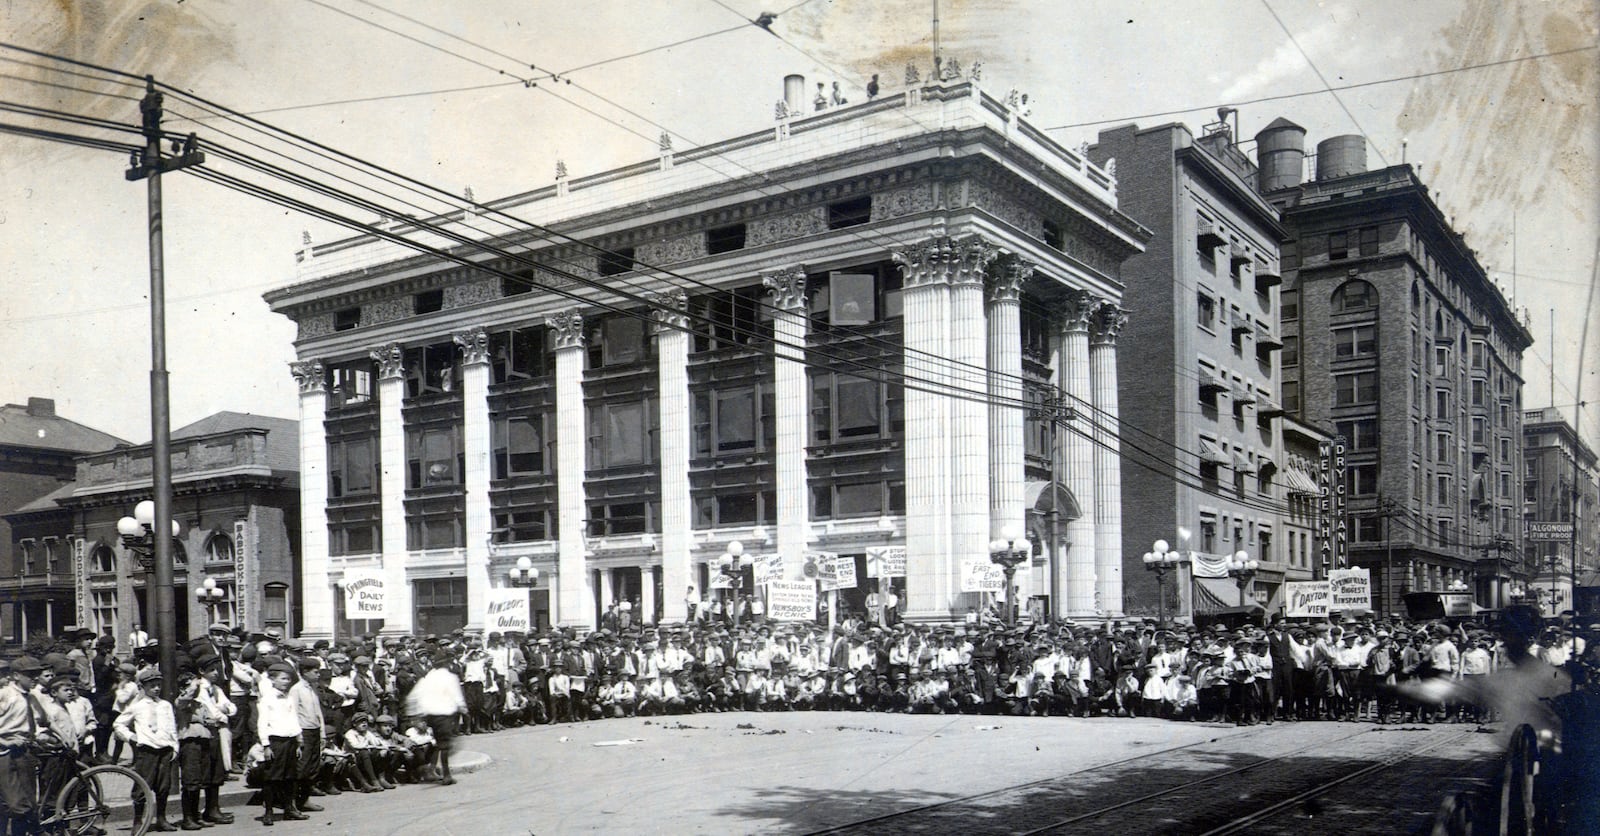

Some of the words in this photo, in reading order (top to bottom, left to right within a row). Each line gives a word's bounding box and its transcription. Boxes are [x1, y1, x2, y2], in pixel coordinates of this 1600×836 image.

[1336, 445, 1346, 478] DRY
[1319, 446, 1331, 578] MENDENHALL
[1337, 485, 1346, 570] CLEANIN
[972, 565, 991, 574] EAST
[983, 570, 1001, 580] END
[346, 578, 384, 600] SPRINGFIELD
[772, 581, 790, 590] NEWS
[790, 582, 812, 591] LEAGUE
[979, 580, 1002, 589] TIGERS
[1341, 586, 1365, 594] BIGGEST
[360, 591, 384, 600] DAILY
[1299, 591, 1328, 608] DAYTON
[1333, 594, 1368, 604] NEWSPAPER
[358, 600, 383, 611] NEWS
[1307, 605, 1327, 614] VIEW
